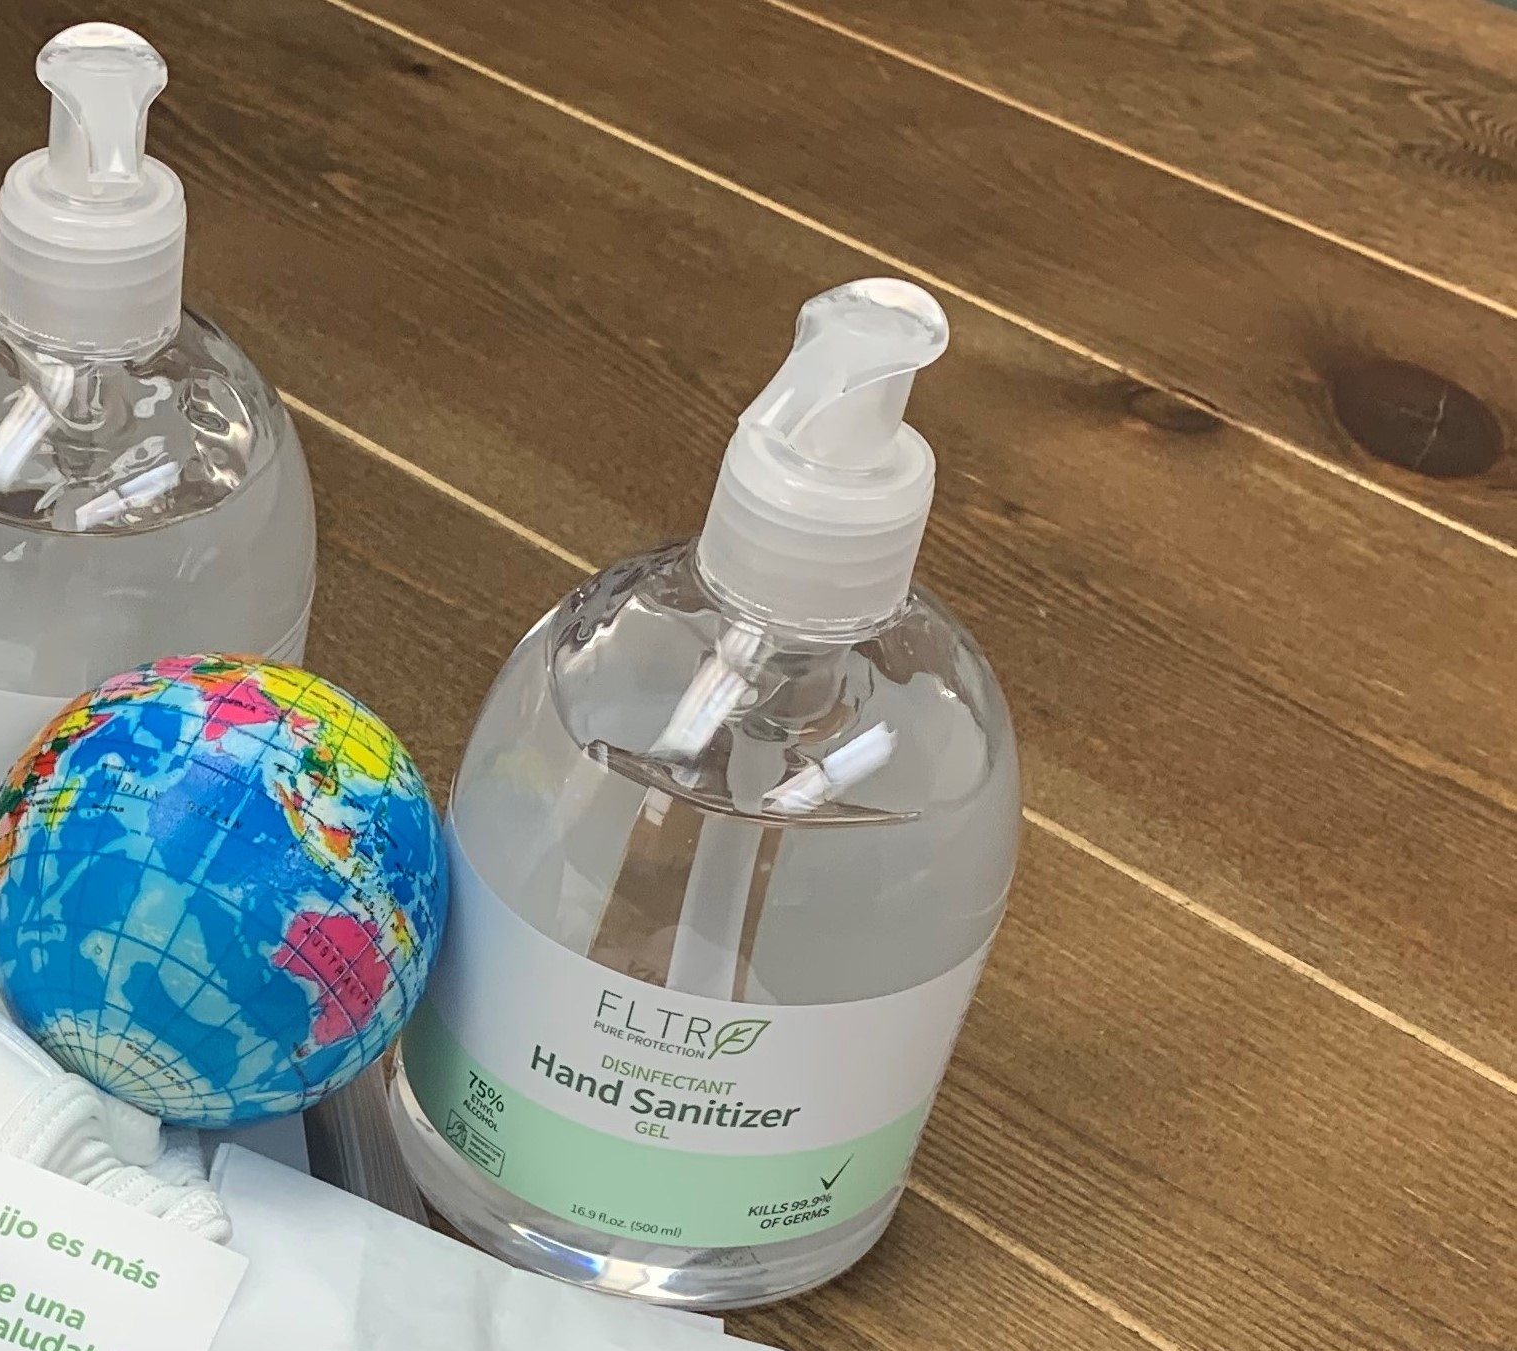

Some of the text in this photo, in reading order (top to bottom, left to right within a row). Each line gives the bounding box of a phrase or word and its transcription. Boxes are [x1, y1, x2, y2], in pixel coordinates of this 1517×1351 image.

[596, 990, 712, 1047] FLTR
[593, 1020, 705, 1059] PURE PROTECTION
[469, 1070, 504, 1113] 75%
[530, 1044, 801, 1129] Hand Sanitizer
[601, 1054, 736, 1096] DISINFECTANT
[463, 1099, 498, 1132] ALCOHOL
[471, 1094, 494, 1118] ETHYL
[634, 1121, 670, 1140] GEL
[571, 1204, 596, 1219] 16.9
[630, 1221, 658, 1234] (500
[661, 1227, 682, 1238] ml)
[747, 1192, 832, 1217] KILLS 99.9%
[760, 1205, 831, 1230] OF GERMS
[46, 1231, 85, 1258] es
[90, 1248, 161, 1290] más
[24, 1291, 86, 1332] una
